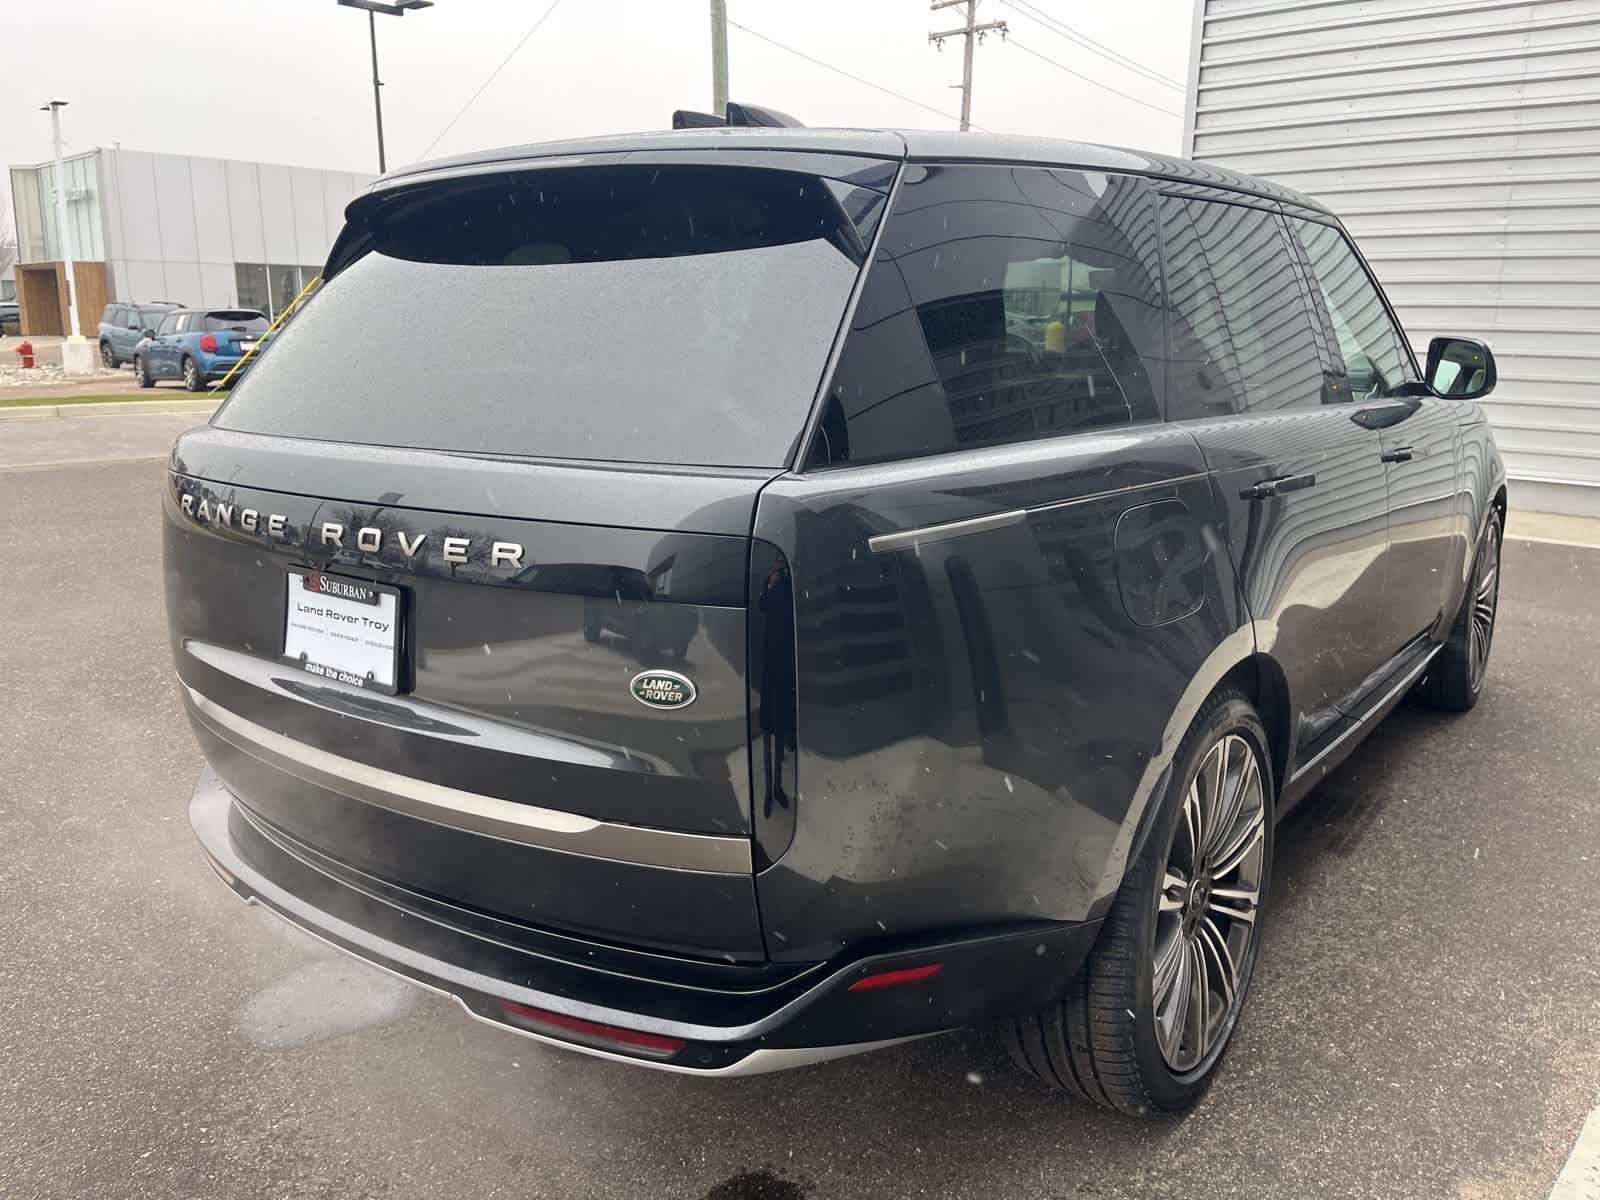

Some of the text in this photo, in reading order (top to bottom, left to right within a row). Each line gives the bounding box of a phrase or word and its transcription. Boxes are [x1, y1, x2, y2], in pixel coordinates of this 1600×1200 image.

[180, 493, 524, 569] RANGE ROVER
[297, 602, 390, 633] Land Rover Troy
[305, 662, 364, 687] make the choice
[642, 678, 673, 691] LAND
[645, 689, 683, 702] ROVER
